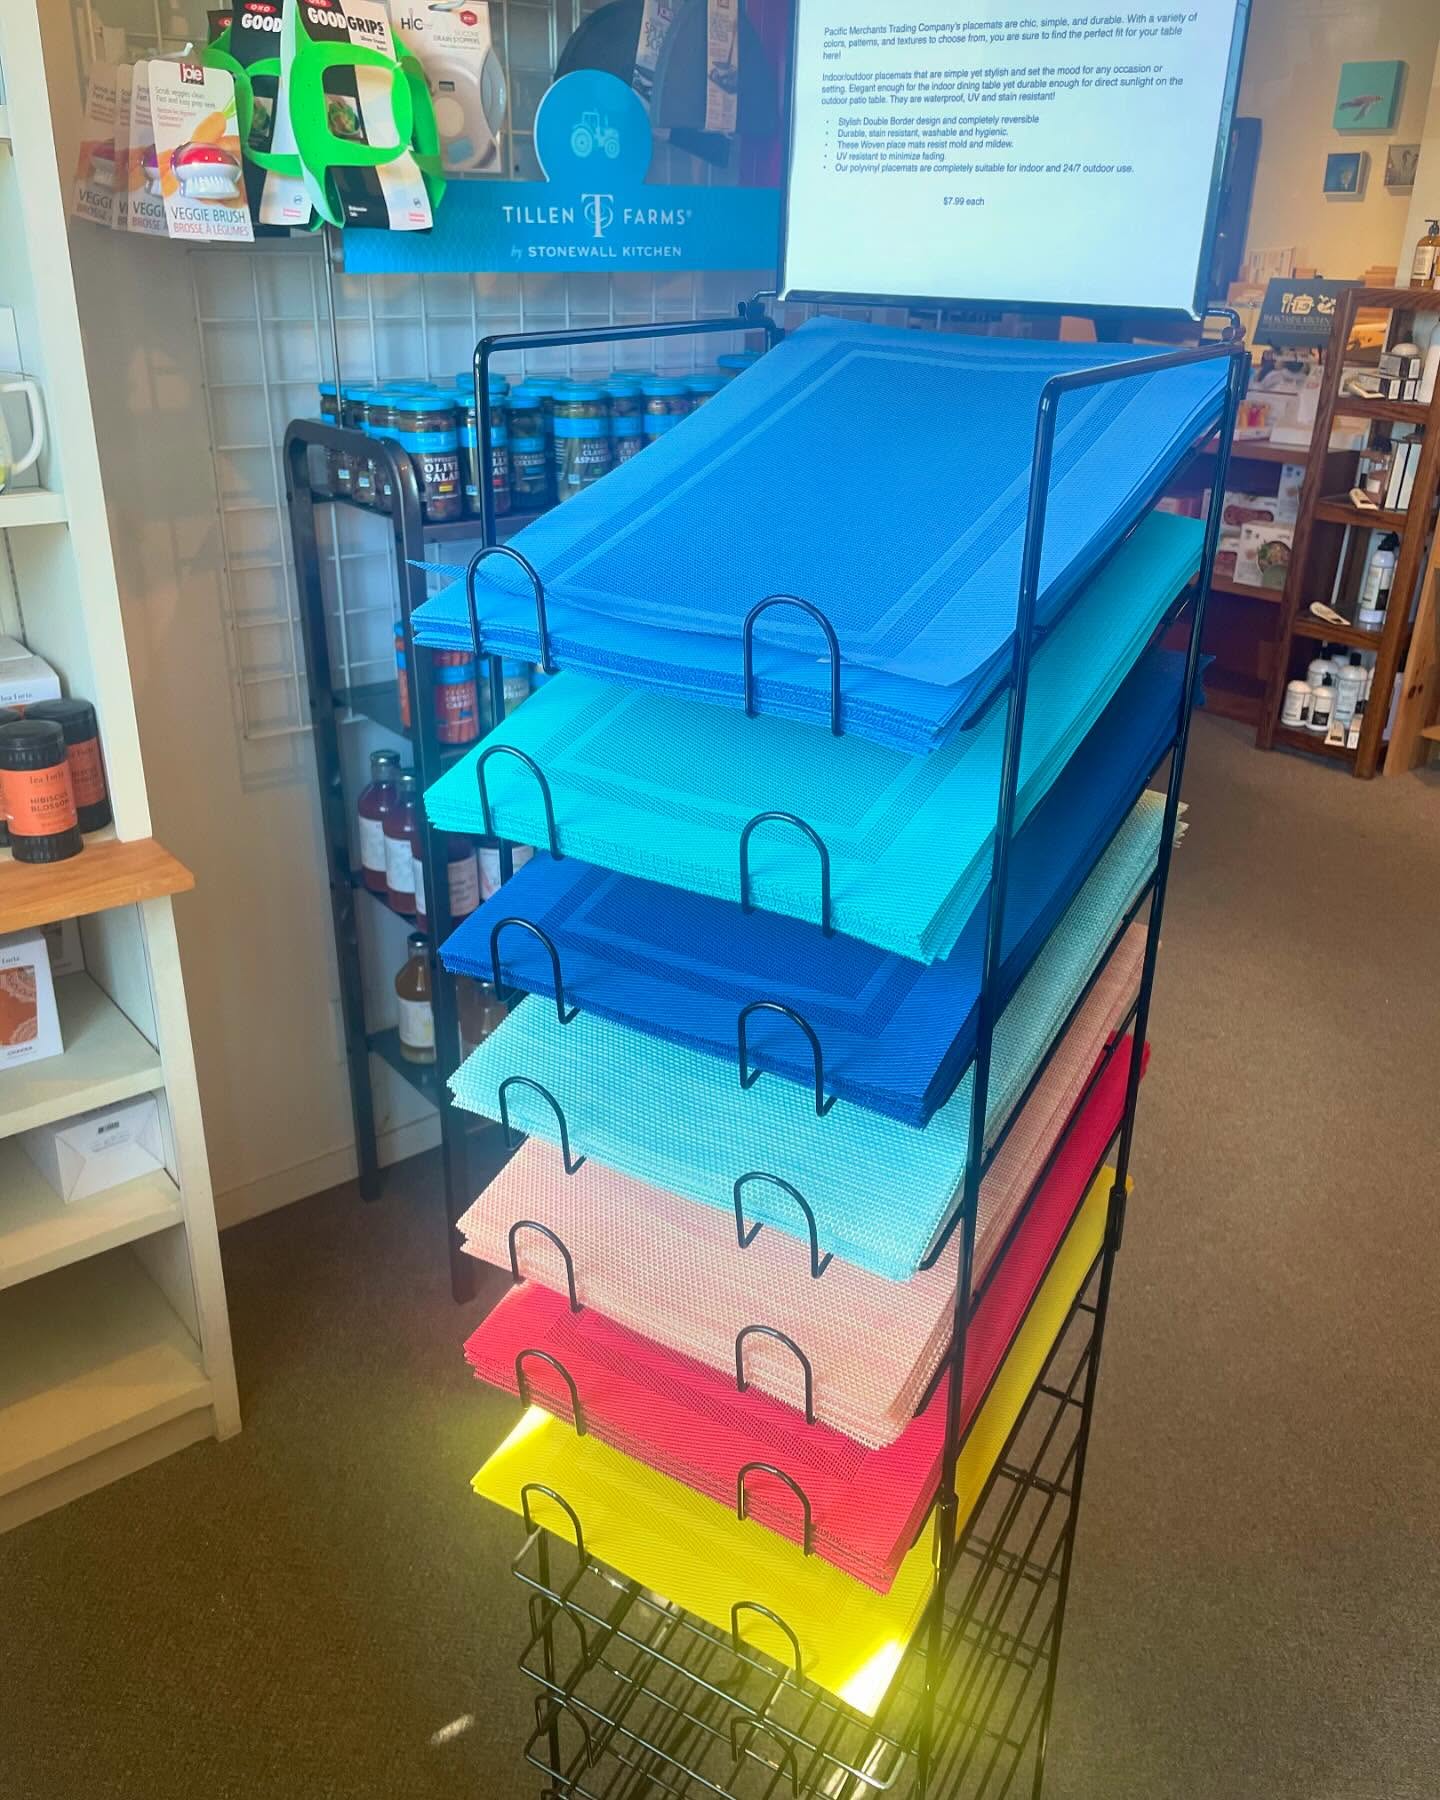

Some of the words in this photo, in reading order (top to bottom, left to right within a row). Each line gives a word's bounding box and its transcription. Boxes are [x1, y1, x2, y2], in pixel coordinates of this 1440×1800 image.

[250, 3, 271, 13] OXO
[241, 13, 282, 33] GOOD
[307, 7, 346, 30] GOOD
[349, 16, 385, 36] GRIPS
[824, 27, 847, 36] Pacific
[850, 25, 886, 35] Merchants
[889, 24, 916, 34] Trading
[918, 22, 961, 32] Company's
[962, 21, 1002, 31] placemats
[1020, 19, 1038, 28] chic,
[1041, 17, 1069, 28] simple,
[1072, 17, 1087, 25] and
[1090, 16, 1124, 25] durable.
[1127, 14, 1146, 23] With
[1157, 13, 1186, 23] variety
[1188, 13, 1198, 22] of
[823, 39, 846, 48] colors,
[848, 38, 879, 48] patterns,
[881, 38, 895, 46] and
[898, 37, 927, 45] textures
[929, 36, 936, 44] to
[938, 34, 966, 43] choose
[968, 33, 988, 42] from,
[990, 34, 1006, 43] you
[1007, 33, 1019, 41] are
[1022, 32, 1039, 40] sure
[1041, 31, 1049, 39] to
[1052, 30, 1066, 39] find
[1069, 29, 1082, 38] the
[1084, 28, 1113, 40] perfect
[1125, 27, 1136, 36] for
[1139, 28, 1158, 39] your
[1160, 26, 1182, 35] table
[823, 52, 841, 60] here!
[822, 73, 873, 81] Indoor/outdoor
[875, 71, 912, 81] placemats
[914, 70, 928, 78] that
[944, 70, 968, 79] simple
[971, 69, 982, 78] yet
[984, 68, 1008, 78] stylish
[1011, 68, 1026, 76] and
[1028, 67, 1040, 75] set
[1042, 66, 1055, 75] the
[1057, 65, 1080, 74] mood
[1082, 64, 1093, 74] for
[1096, 66, 1111, 76] any
[1114, 64, 1151, 73] occasion
[1153, 65, 1163, 73] or
[822, 85, 846, 95] setting.
[849, 84, 876, 95] Elegant
[877, 83, 904, 95] enough
[906, 82, 916, 91] for
[918, 82, 930, 91] the
[932, 82, 955, 90] indoor
[957, 81, 980, 92] dining
[982, 80, 1000, 89] table
[1003, 80, 1015, 91] yet
[1017, 78, 1047, 88] durable
[1050, 78, 1079, 89] enough
[1082, 78, 1093, 87] for
[1095, 77, 1118, 86] direct
[1120, 77, 1154, 88] sunlight
[1156, 77, 1167, 85] on
[1169, 76, 1183, 85] the
[822, 96, 848, 105] outdoor
[849, 95, 867, 106] patio
[868, 95, 887, 103] table.
[890, 94, 907, 105] They
[910, 95, 921, 103] are
[924, 94, 965, 104] waterproof,
[968, 93, 980, 101] UV
[982, 93, 996, 101] and
[999, 92, 1017, 101] stain
[1019, 92, 1055, 100] resistant!
[839, 117, 861, 128] Stylish
[863, 117, 888, 125] Double
[890, 117, 914, 125] Border
[916, 116, 940, 126] design
[943, 116, 956, 125] and
[958, 115, 999, 126] completely
[1001, 115, 1039, 124] reversible
[869, 129, 885, 137] stain
[888, 128, 919, 138] resistant,
[922, 128, 957, 136] washable
[959, 128, 973, 136] and
[975, 128, 1008, 138] hygienic.
[838, 141, 859, 149] These
[861, 141, 885, 149] Woven
[886, 141, 906, 150] place
[908, 141, 925, 149] mats
[927, 140, 948, 148] resist
[949, 140, 967, 148] mold
[969, 140, 983, 148] and
[985, 140, 1014, 148] mildew.
[836, 152, 847, 160] UV
[849, 152, 878, 160] resistant
[880, 152, 887, 160] to
[889, 152, 921, 160] minimize
[835, 164, 848, 172] Our
[850, 163, 879, 173] polyvinyl
[882, 163, 918, 173] placemats
[934, 163, 973, 173] completely
[975, 163, 1005, 172] suitable
[1007, 164, 1017, 172] for
[1019, 164, 1044, 172] indoor
[1046, 163, 1061, 172] and
[1063, 164, 1081, 172] 24/7
[1083, 164, 1114, 172] outdoor
[80, 189, 112, 210] VEGGI
[943, 197, 964, 205] $7.99
[966, 197, 984, 205] each
[133, 200, 165, 218] VEGGI
[171, 206, 210, 223] VEGGIE
[213, 208, 246, 224] BRUSH
[502, 205, 574, 224] TILLEN
[174, 222, 202, 234] BROSSE
[510, 244, 523, 262] by
[528, 245, 617, 258] STONEWALL
[622, 246, 682, 257] KITCHEN
